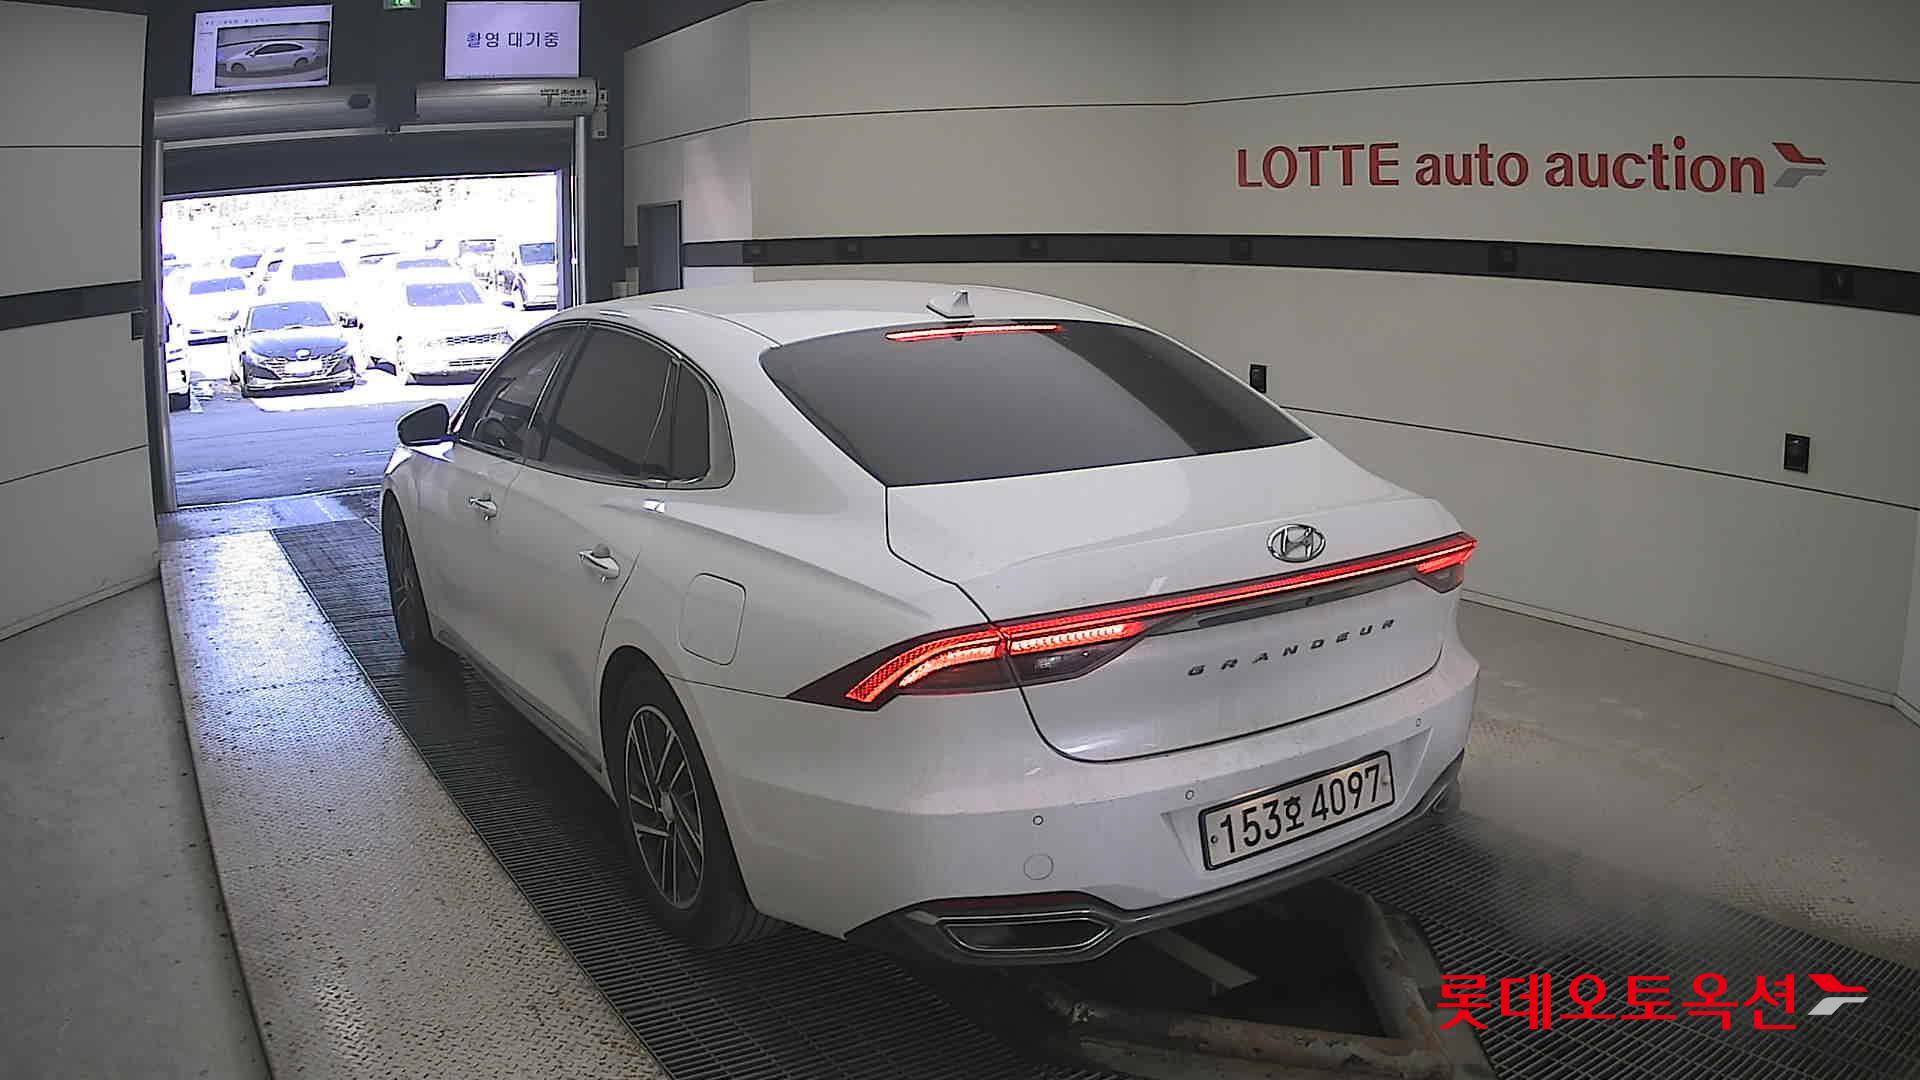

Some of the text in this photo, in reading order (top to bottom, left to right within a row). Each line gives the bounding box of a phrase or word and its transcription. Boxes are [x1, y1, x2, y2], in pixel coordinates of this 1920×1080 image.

[508, 31, 559, 48] 대기중
[1237, 135, 1765, 194] LOTTE auto auction
[1188, 619, 1395, 676] GRANDEUR
